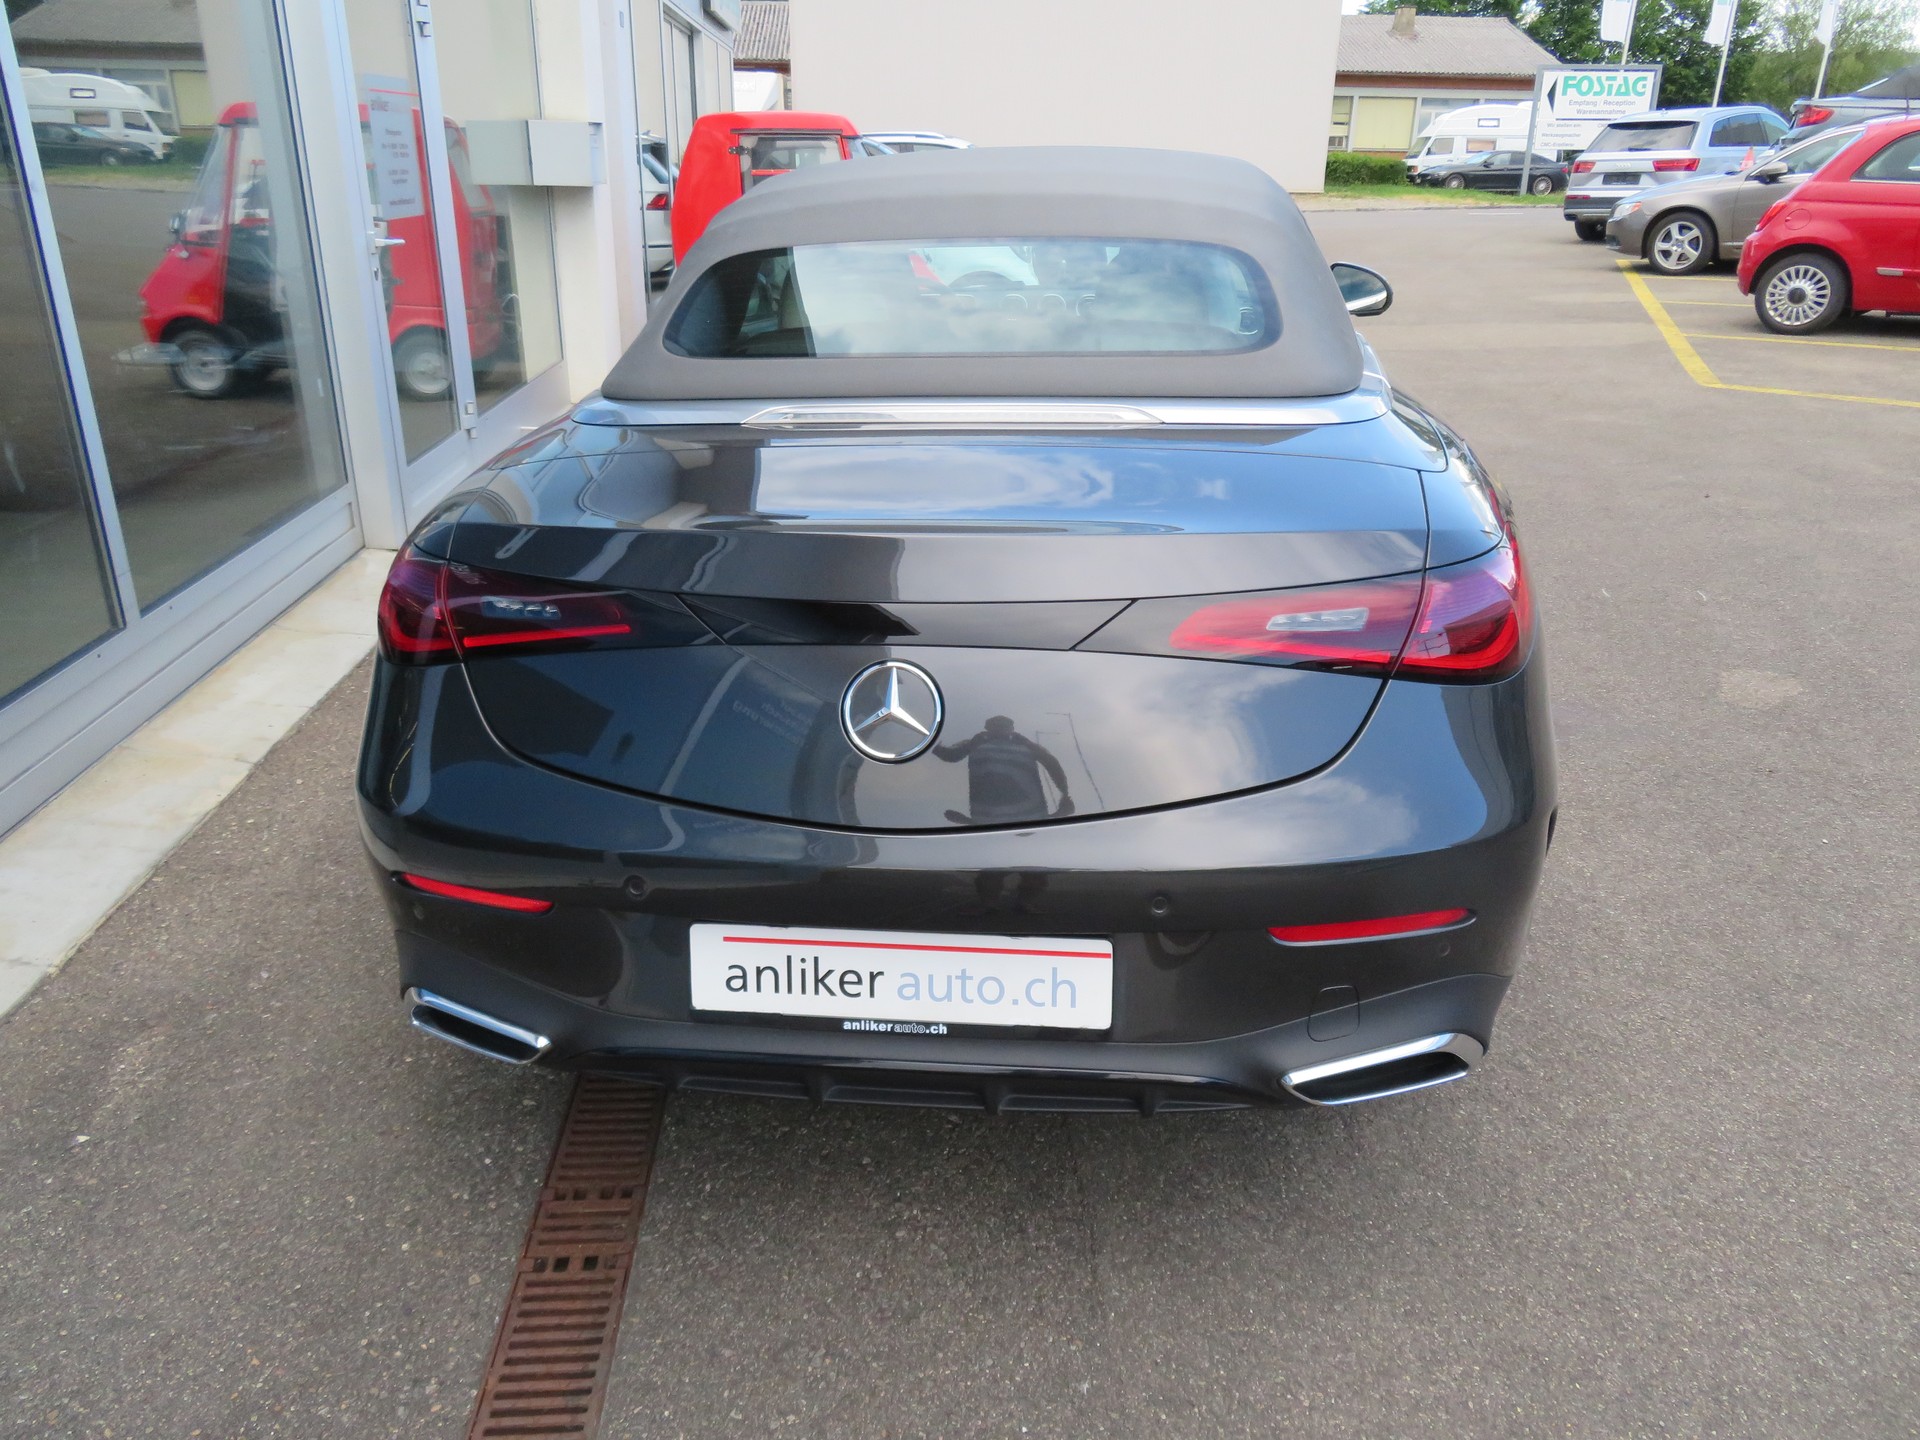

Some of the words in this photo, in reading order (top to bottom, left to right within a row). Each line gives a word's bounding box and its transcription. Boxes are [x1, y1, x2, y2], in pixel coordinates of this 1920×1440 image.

[1561, 75, 1649, 97] FOSTAG
[1568, 100, 1598, 108] Empfang
[1602, 100, 1637, 108] Reception
[725, 955, 885, 999] anliker
[896, 966, 1078, 1009] auto.ch
[843, 1020, 948, 1035] anlikerauto.ch
